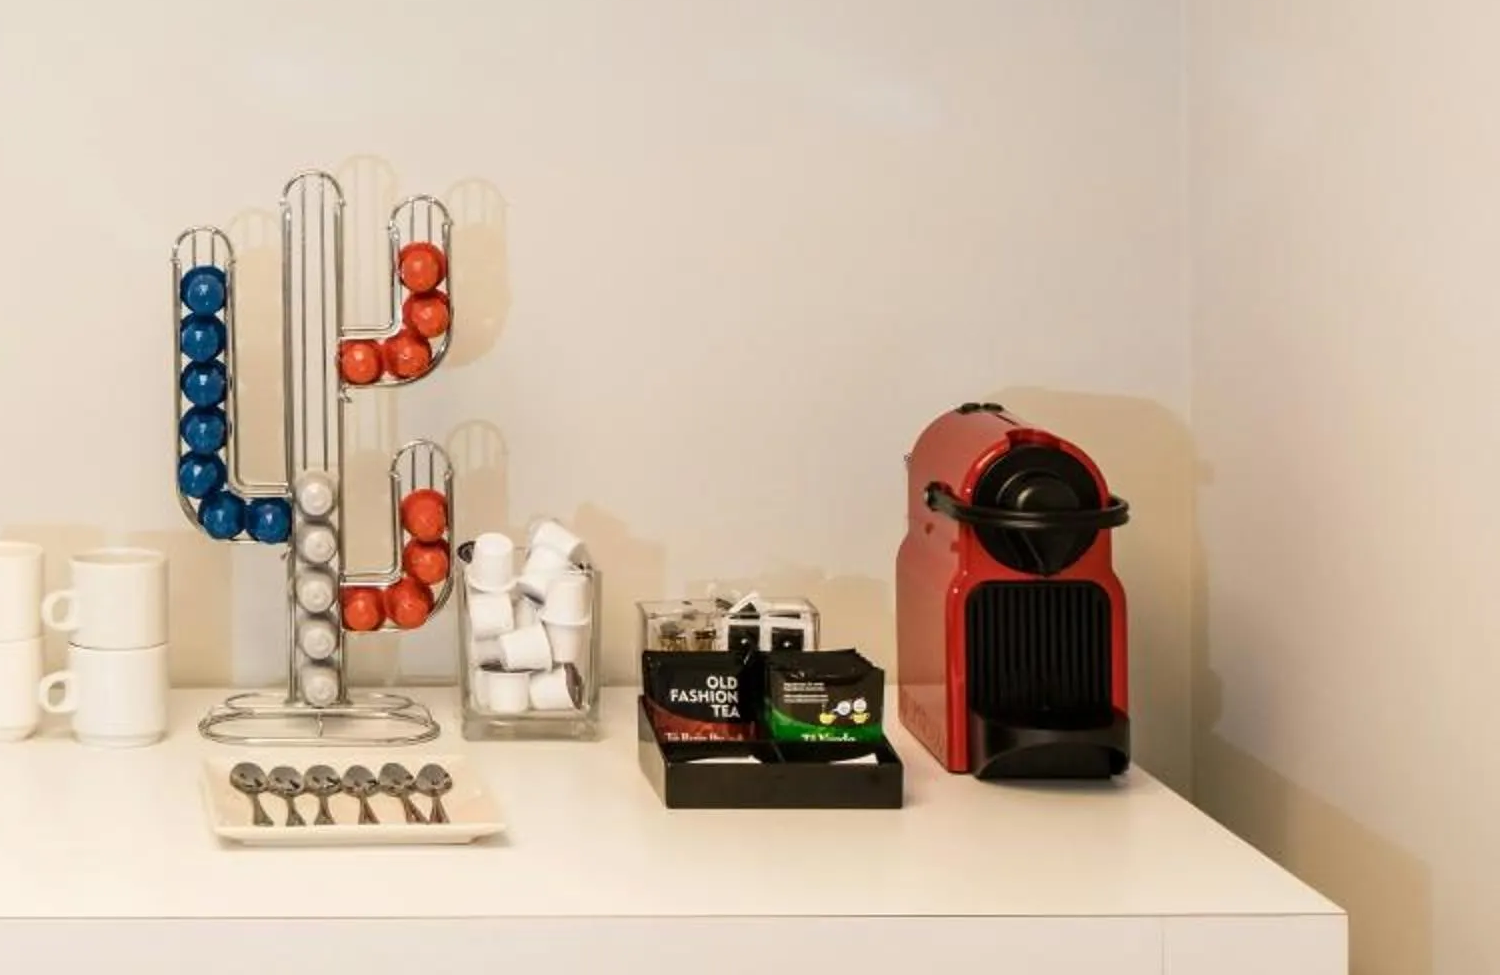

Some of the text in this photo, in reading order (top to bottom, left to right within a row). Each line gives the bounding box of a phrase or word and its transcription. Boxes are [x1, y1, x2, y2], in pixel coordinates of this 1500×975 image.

[707, 676, 738, 689] OLD
[670, 688, 739, 703] FASHION
[711, 705, 741, 718] TEA
